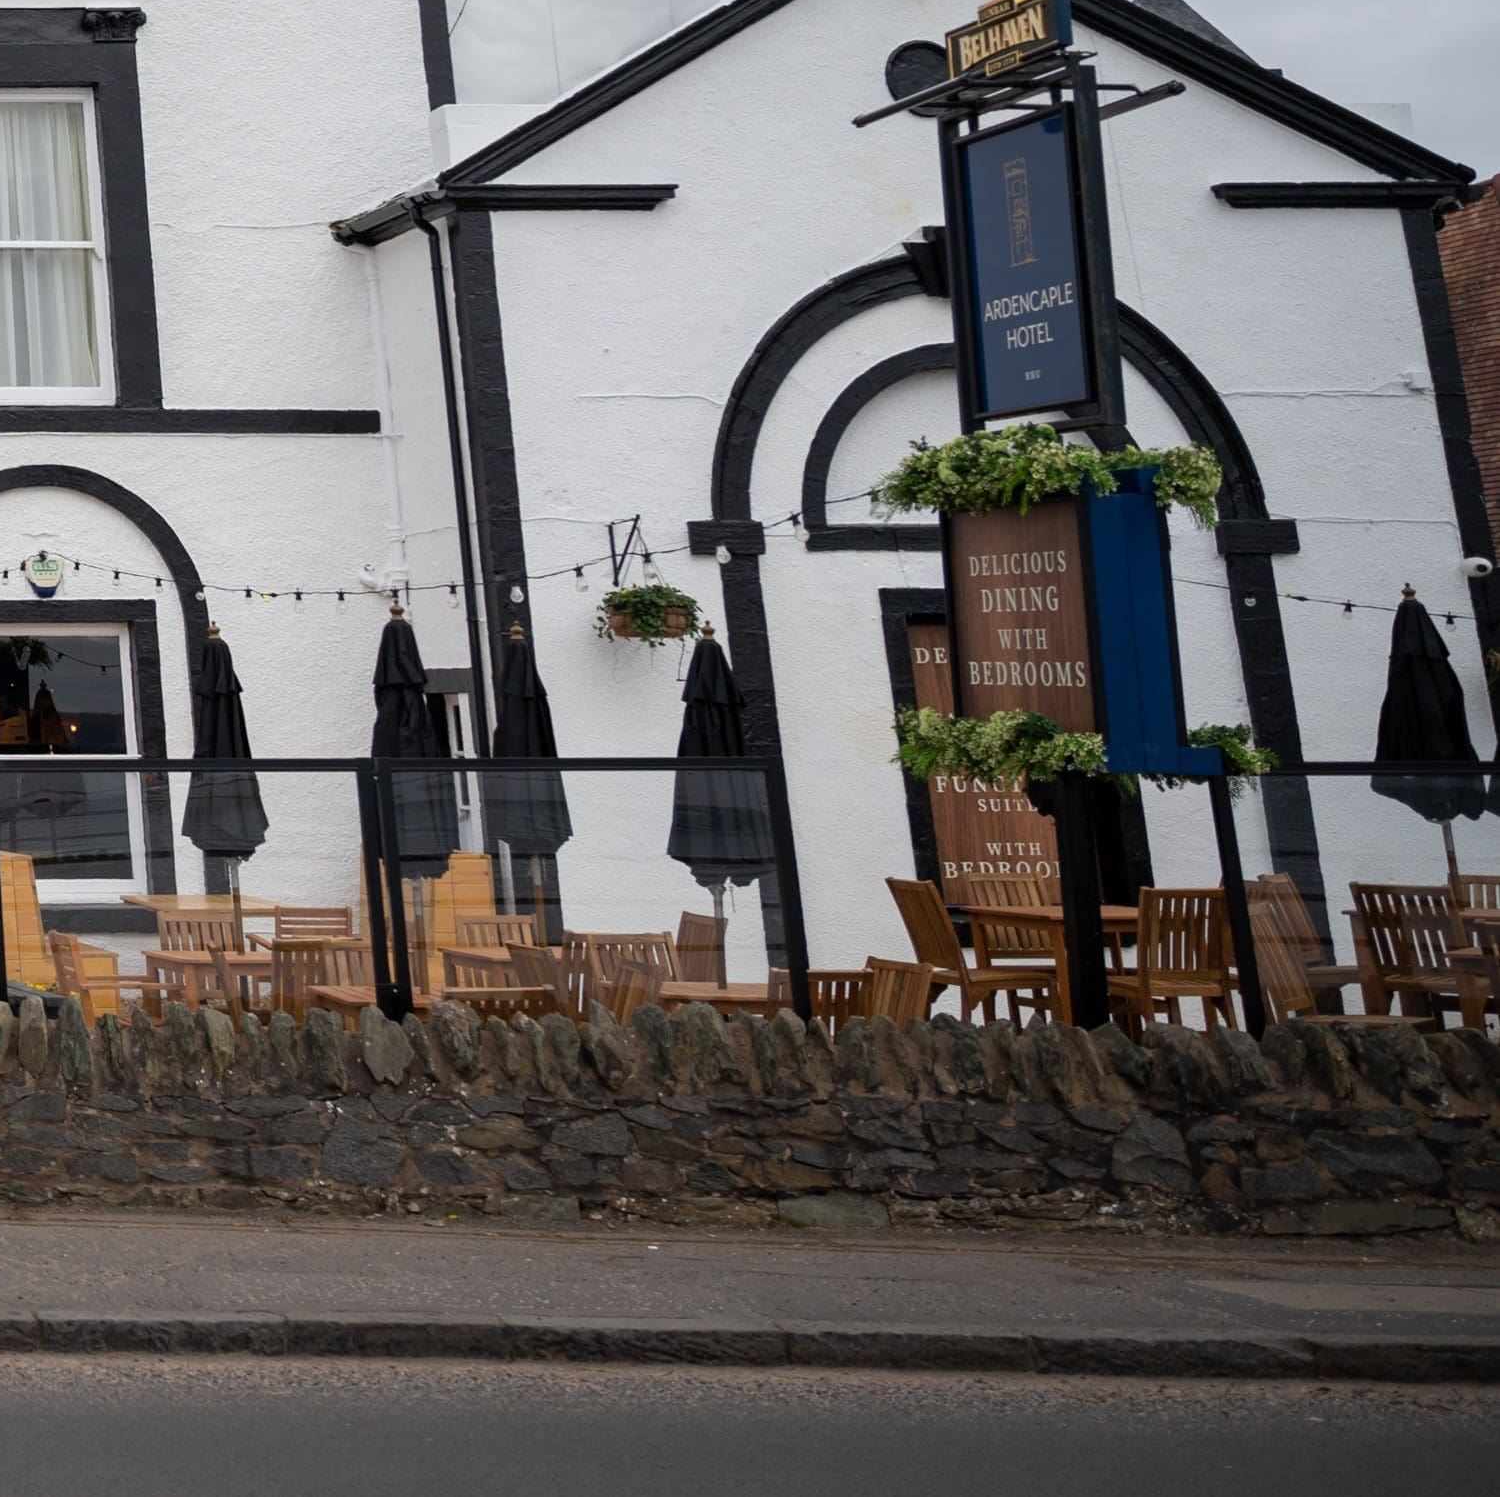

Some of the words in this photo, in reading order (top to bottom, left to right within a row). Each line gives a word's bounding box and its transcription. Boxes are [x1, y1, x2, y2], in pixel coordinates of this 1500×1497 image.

[958, 3, 1047, 72] BELHAVEN
[984, 282, 1074, 322] ARDENCAPLE
[1006, 321, 1054, 350] HOTEL
[968, 550, 1067, 577] DELICIOUS
[980, 585, 1060, 613] DINING
[997, 628, 1048, 650] WITH
[968, 661, 1087, 688] BEDROOMS
[934, 775, 1023, 793] FUNCT
[985, 842, 1042, 856] WITH
[943, 861, 1061, 879] BEDROO
